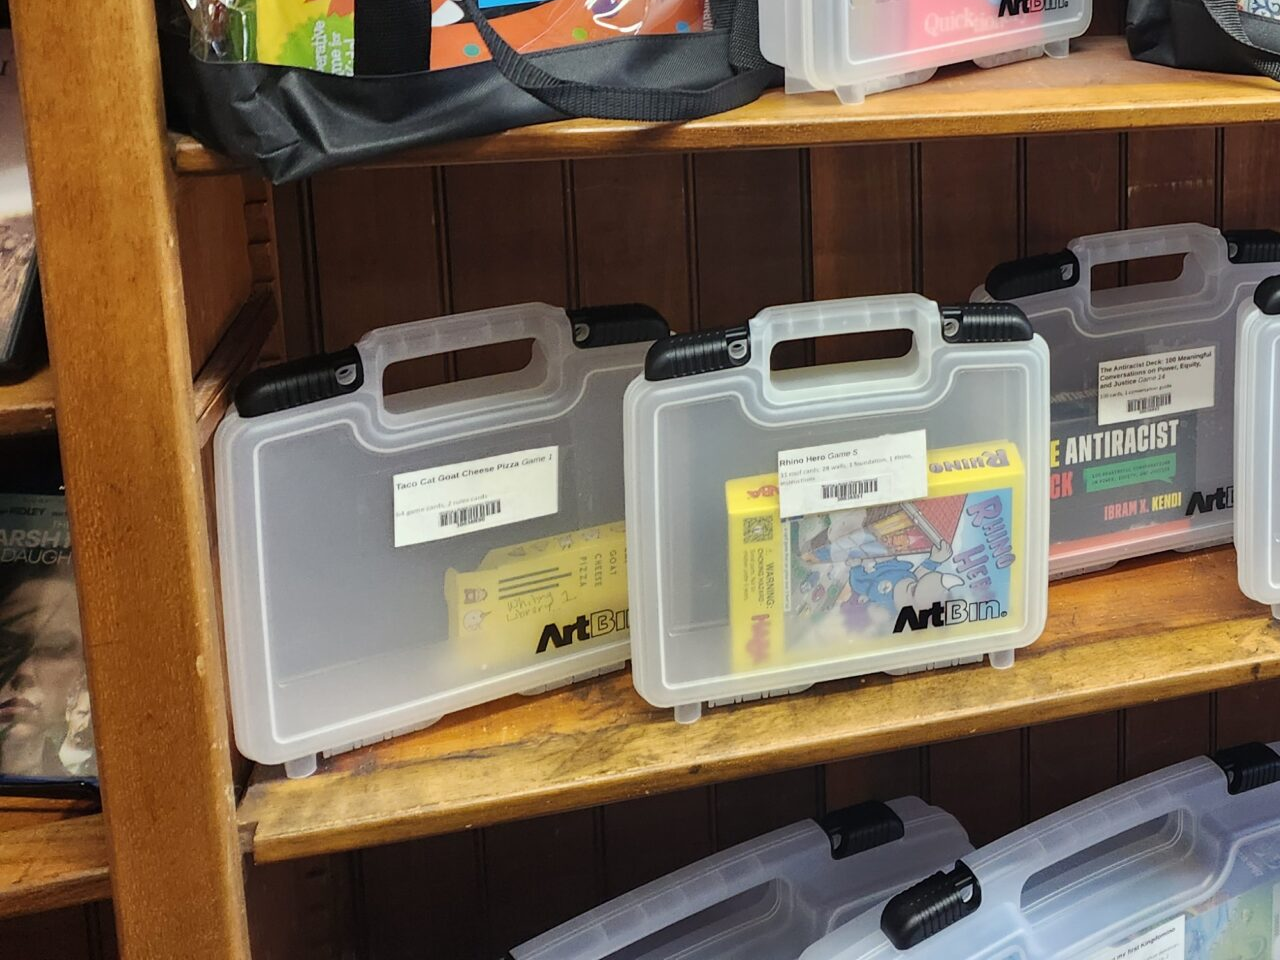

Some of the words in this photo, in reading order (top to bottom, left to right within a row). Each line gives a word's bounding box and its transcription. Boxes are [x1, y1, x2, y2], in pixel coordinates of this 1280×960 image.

[1100, 369, 1146, 382] Conversations
[1157, 365, 1179, 374] Power,
[1180, 361, 1202, 370] Equity,
[1113, 361, 1145, 372] Antiracist
[1178, 351, 1212, 362] Meaningful
[1113, 378, 1137, 387] Justice
[1065, 418, 1180, 466] ANTIRACIST
[396, 481, 418, 491] Taco
[419, 477, 436, 486] Cat
[438, 472, 459, 482] Goat
[461, 466, 495, 477] Cheese
[497, 460, 520, 472] Pizza
[521, 455, 546, 466] Game
[779, 458, 804, 467] Rhino
[806, 454, 826, 463] Hero
[828, 451, 851, 460] Game
[929, 449, 1009, 474] RHINO
[1050, 470, 1073, 500] CK
[1103, 499, 1138, 520] IBRAM
[1151, 491, 1182, 512] KENDI
[966, 495, 1016, 570] RHINO
[1, 547, 73, 565] DAUGH
[594, 552, 602, 588] CHEESE
[609, 549, 617, 576] GOAT
[579, 555, 588, 587] PIZZA
[766, 562, 775, 609] WARNING:
